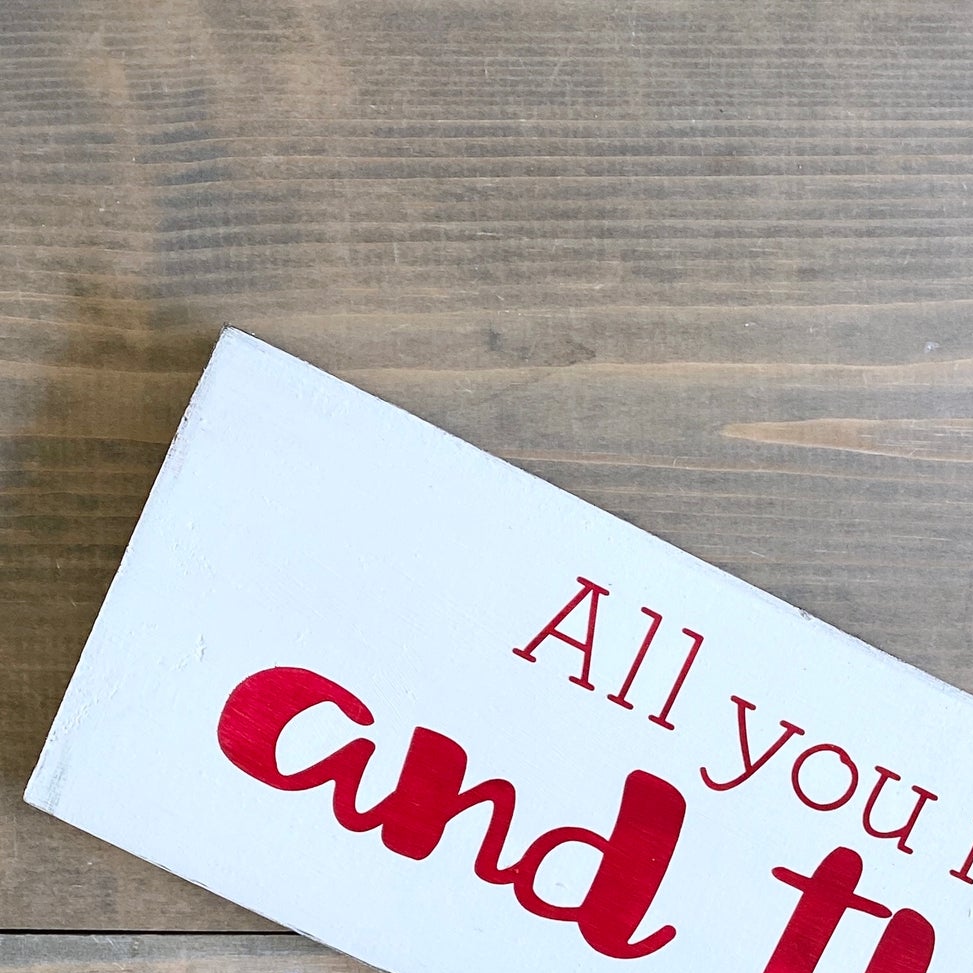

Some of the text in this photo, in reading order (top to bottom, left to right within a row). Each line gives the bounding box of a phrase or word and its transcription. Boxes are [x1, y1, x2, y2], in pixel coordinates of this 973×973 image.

[217, 666, 686, 959] and
[513, 577, 703, 730] All
[701, 696, 937, 854] you
